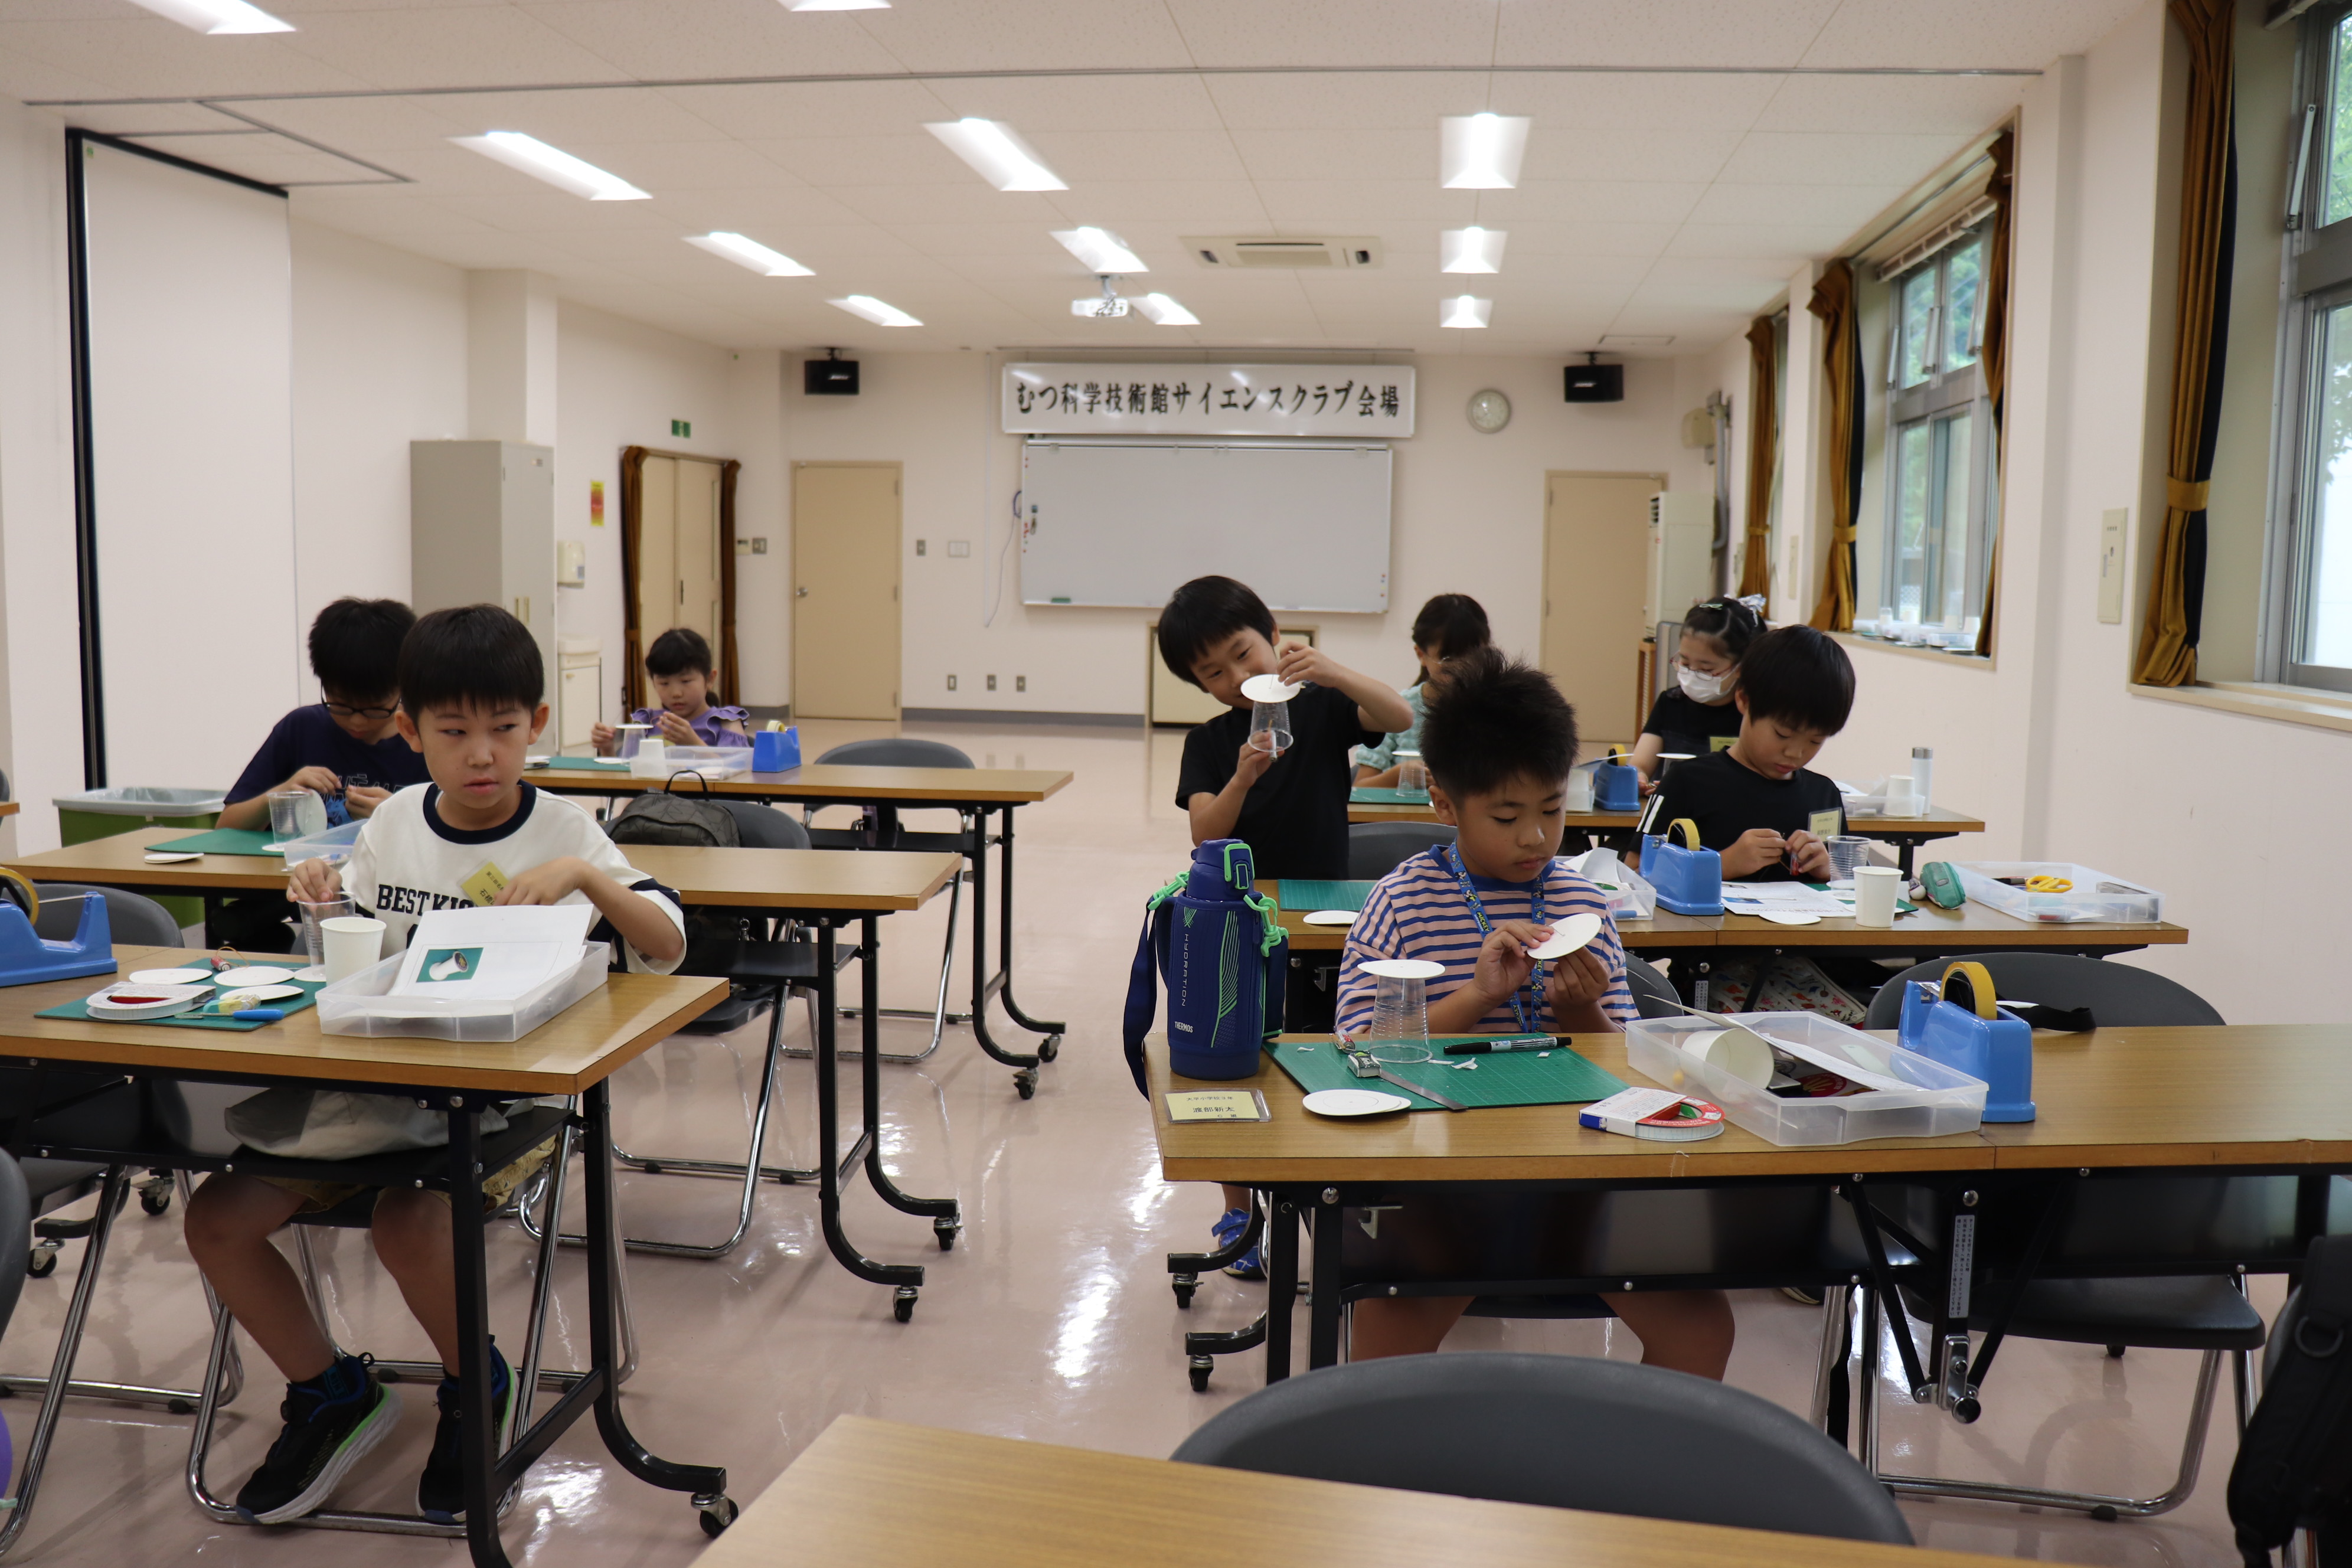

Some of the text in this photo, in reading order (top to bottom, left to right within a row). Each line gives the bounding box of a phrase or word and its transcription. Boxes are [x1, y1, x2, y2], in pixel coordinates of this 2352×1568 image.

[1017, 380, 1400, 418] むつ科学技術館サイエンスクラブ会場
[377, 884, 430, 916] BEST
[479, 888, 496, 906] 石橋
[1476, 912, 1491, 932] MICKEY
[1174, 1021, 1194, 1033] THERMOS
